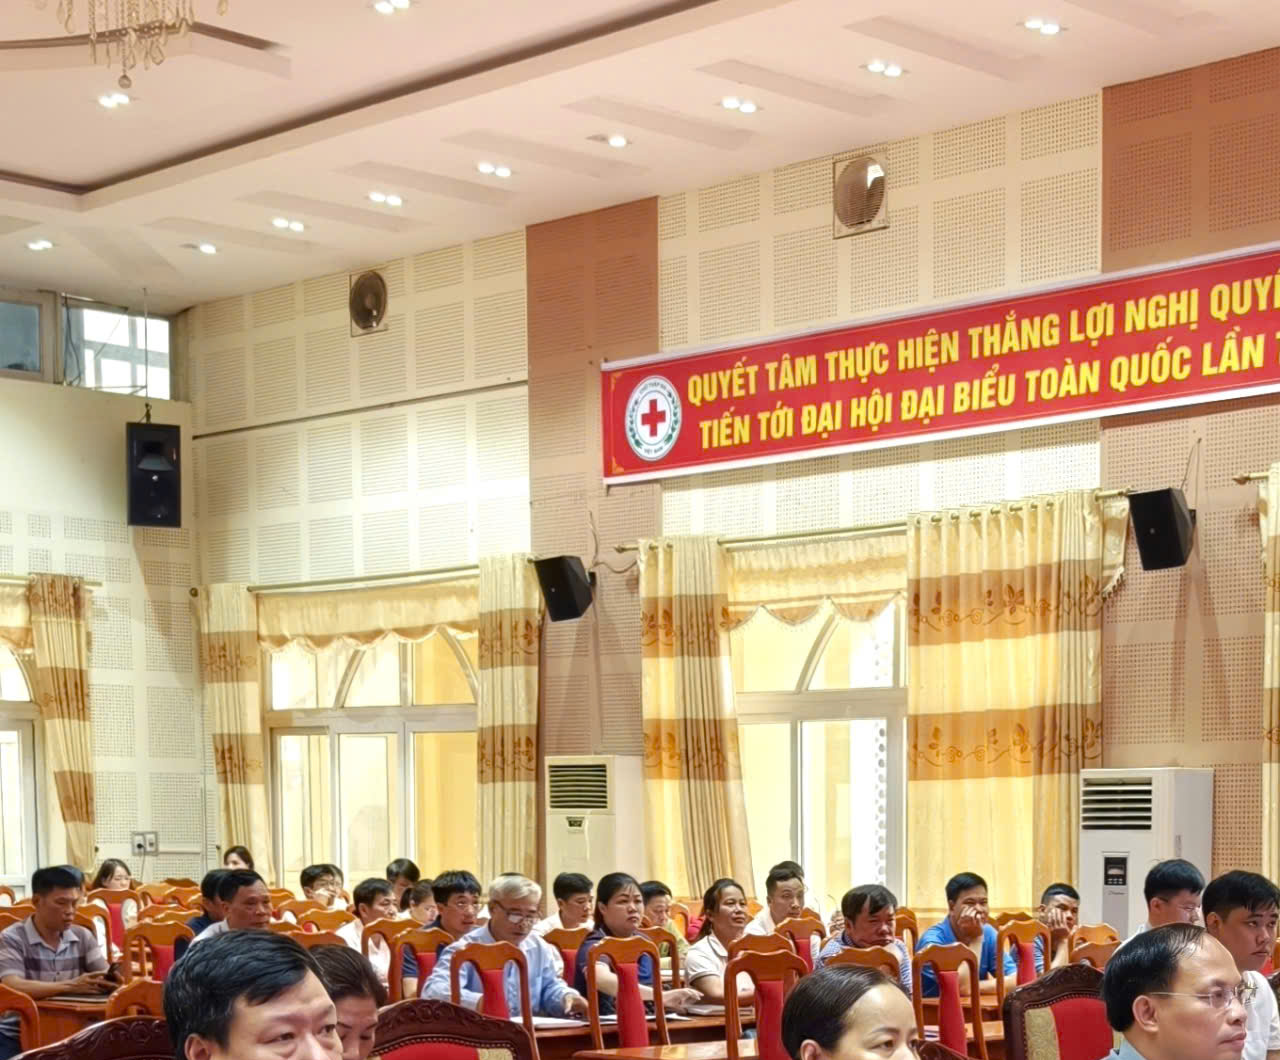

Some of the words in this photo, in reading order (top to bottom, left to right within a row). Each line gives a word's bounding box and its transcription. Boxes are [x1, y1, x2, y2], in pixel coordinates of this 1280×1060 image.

[687, 357, 758, 406] QUYẾT
[765, 354, 817, 392] TÂM
[824, 342, 890, 384] THỰC
[898, 328, 959, 373] HIỆN
[968, 311, 1060, 359] THẮNG
[1069, 302, 1114, 346] LỢI
[1124, 289, 1199, 332] NGHỊ
[699, 403, 750, 449] TIẾN
[757, 396, 794, 440] TỚI
[801, 400, 843, 438] ĐẠI
[850, 389, 893, 438] HỘI
[900, 384, 945, 425] ĐẠI
[953, 364, 1016, 414] BIỂU
[1024, 358, 1101, 403] TOÀN
[1109, 338, 1192, 392] QUỐC
[1201, 325, 1265, 377] LẦN
